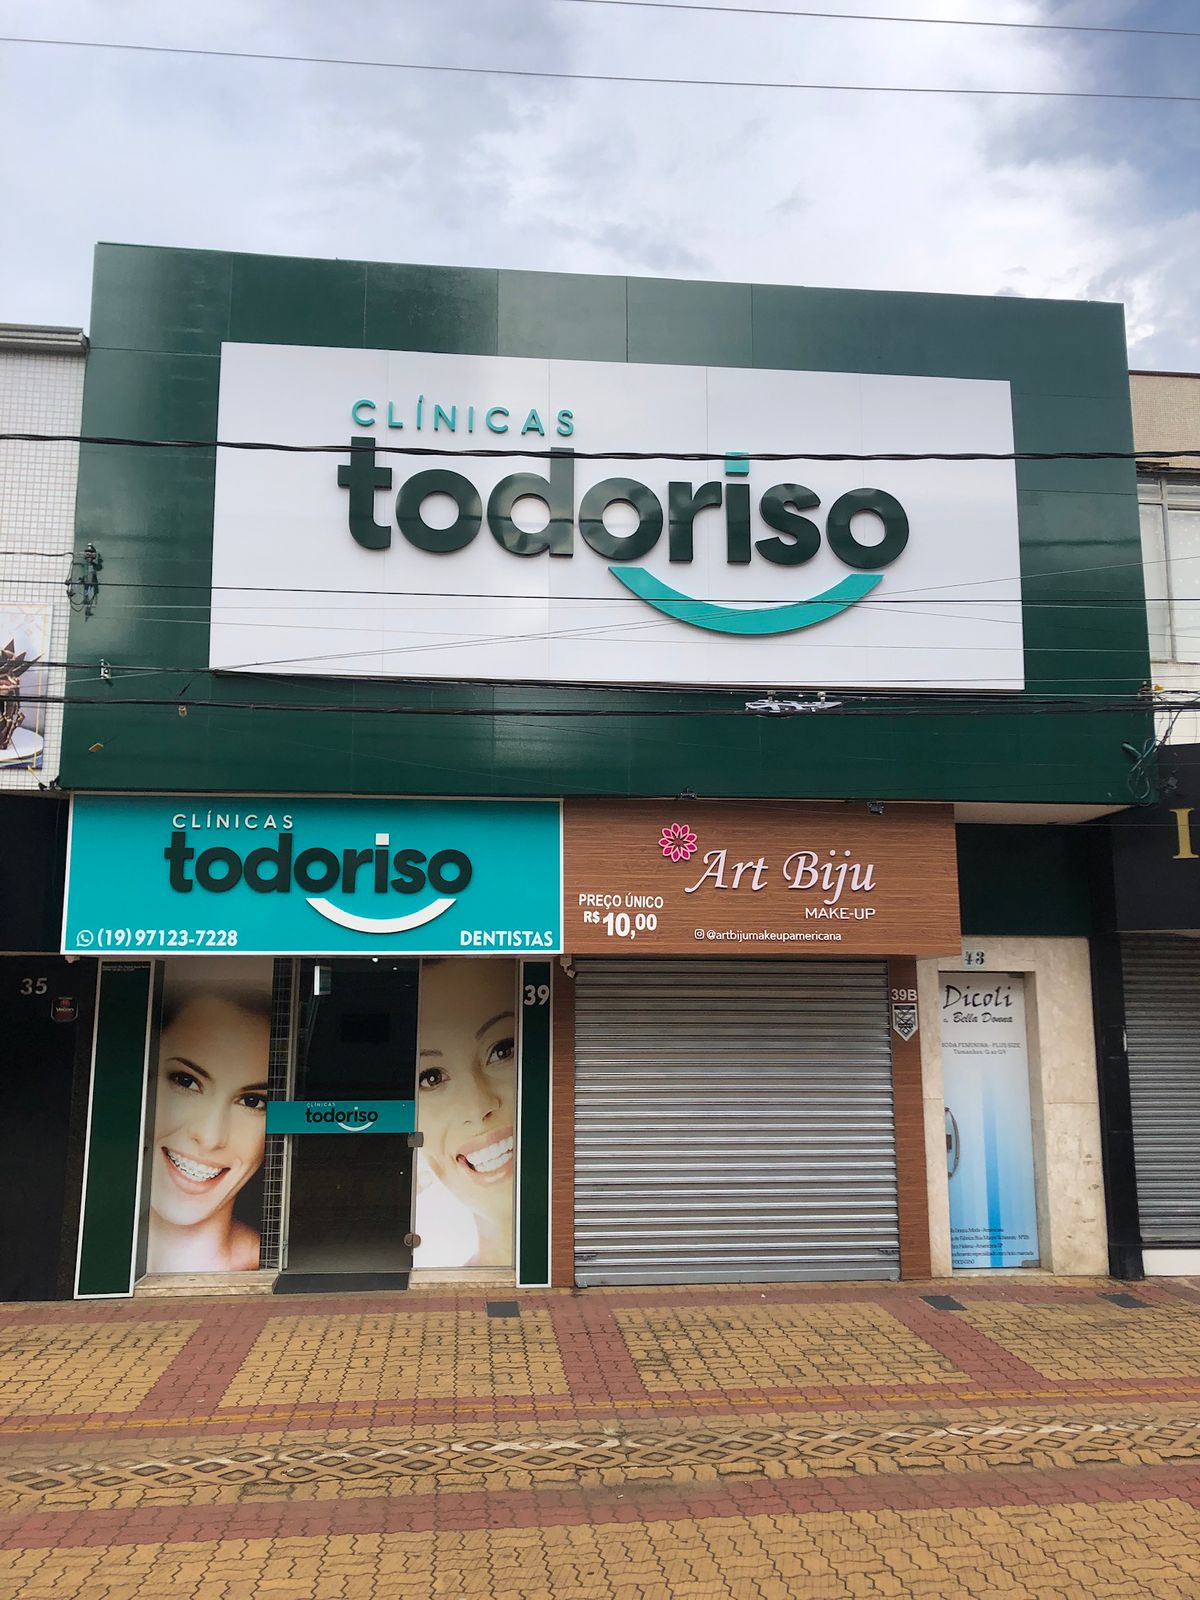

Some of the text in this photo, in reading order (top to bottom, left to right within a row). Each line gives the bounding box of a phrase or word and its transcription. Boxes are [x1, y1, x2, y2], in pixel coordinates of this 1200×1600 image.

[351, 394, 575, 437] CLÍNICAS
[337, 436, 909, 570] todoriso
[172, 811, 293, 829] CLÍNICAS
[164, 831, 473, 893] todoriso
[684, 849, 876, 905] Art Biju
[578, 892, 664, 909] PREÇO ÚNICO
[805, 907, 876, 920] MAKE-UP
[583, 910, 657, 940] R$ 10,00
[460, 930, 553, 947] DENTISTAS
[706, 930, 842, 943] @artbijumakeupamericana
[964, 951, 985, 965] 43
[20, 977, 48, 995] 35
[523, 984, 550, 1006] 39
[891, 988, 918, 1001] 39B
[942, 984, 1013, 1009] Dicoli
[952, 1011, 979, 1023] Bella
[981, 1012, 1013, 1023] Donna
[305, 1106, 379, 1123] todoriso
